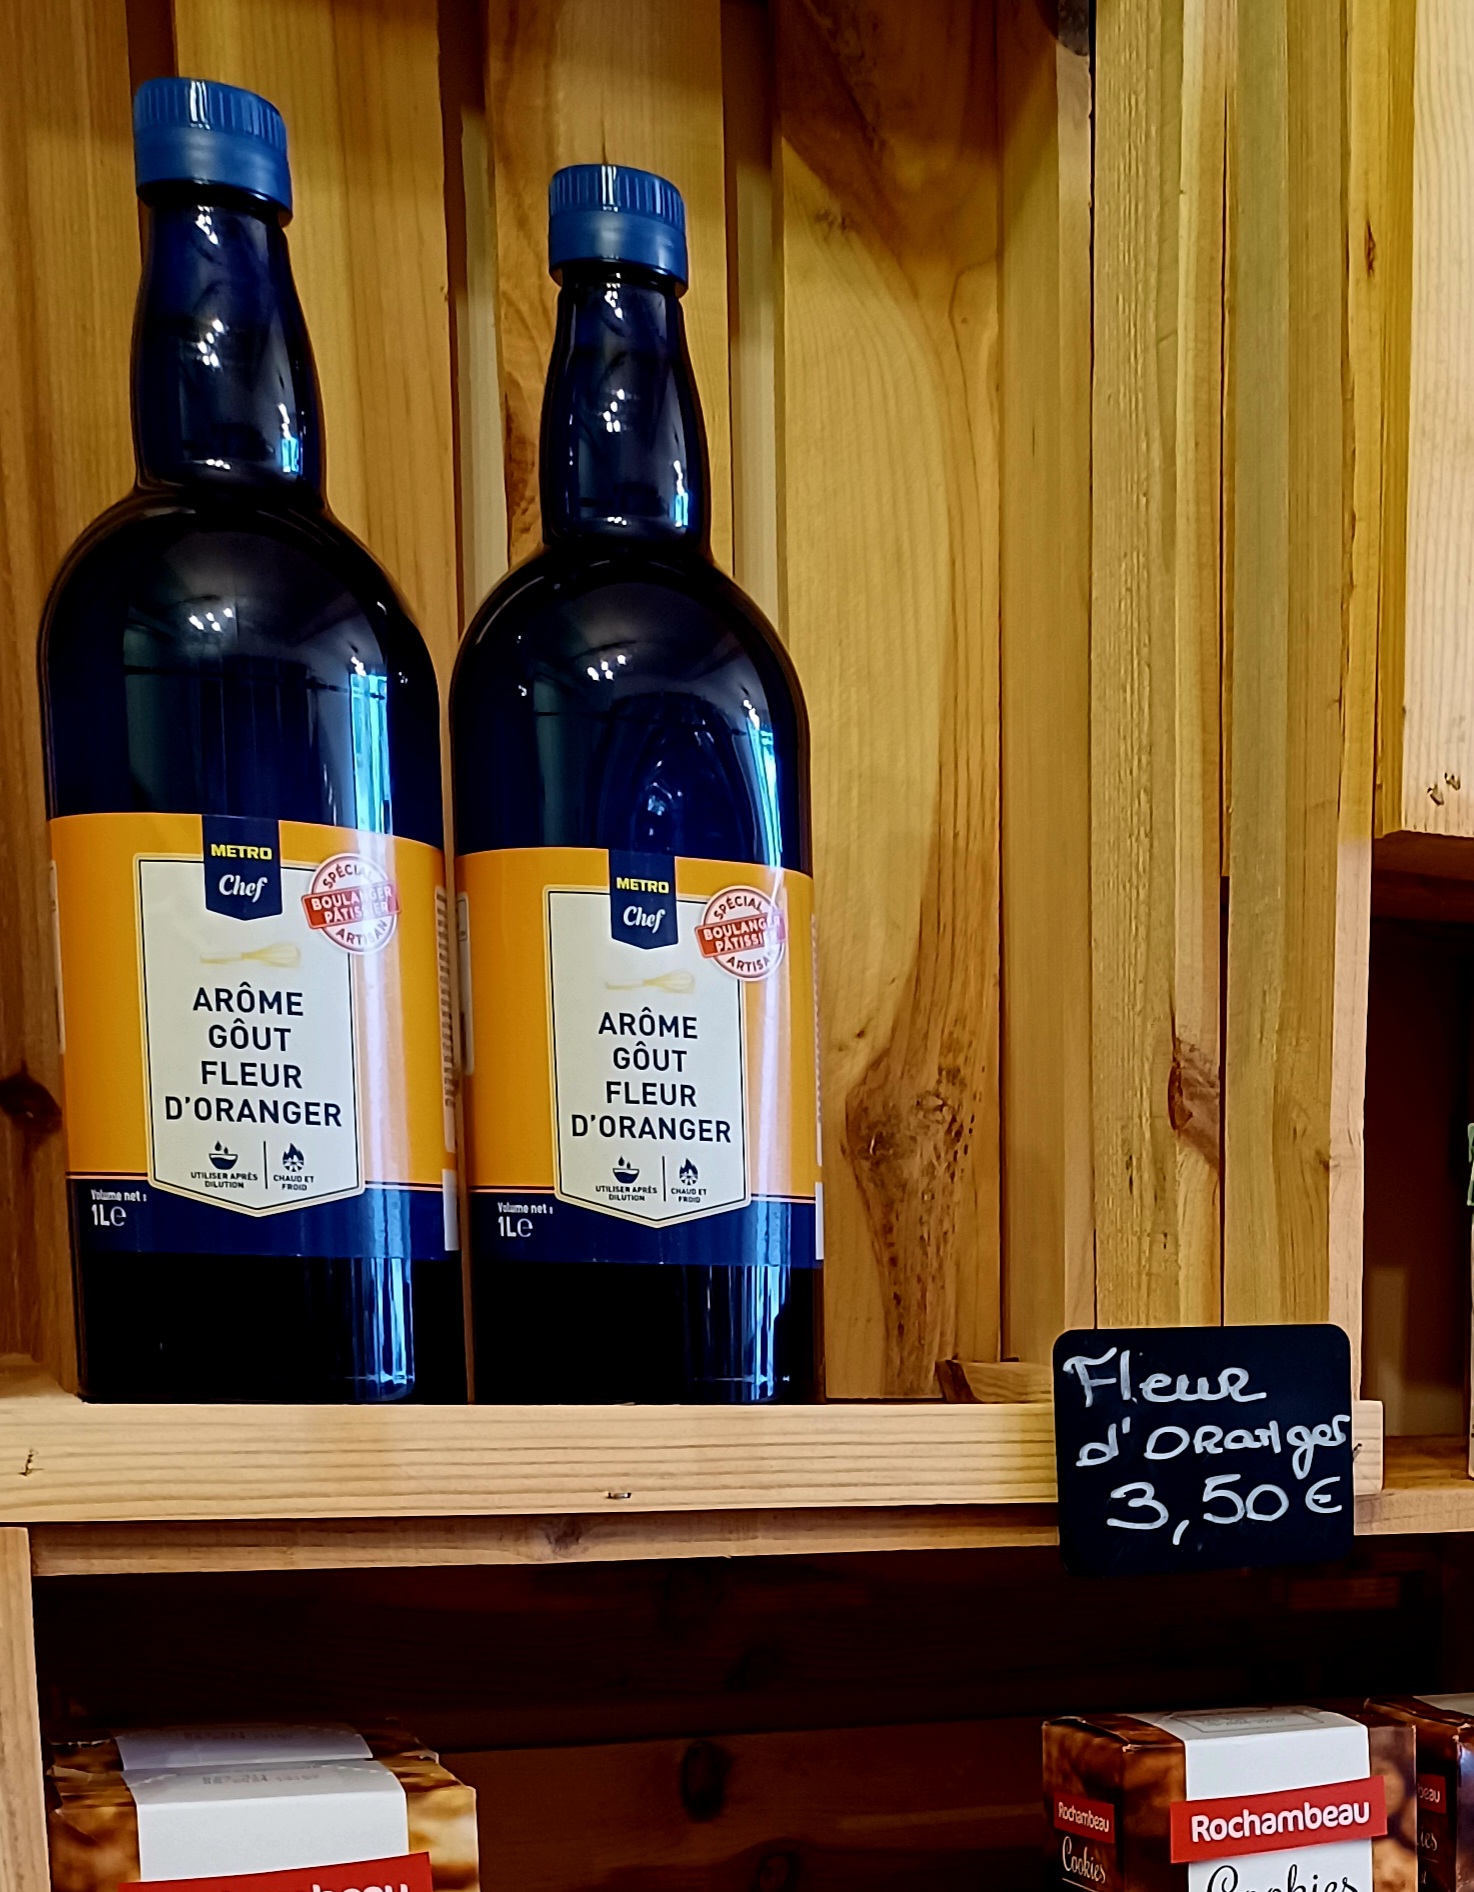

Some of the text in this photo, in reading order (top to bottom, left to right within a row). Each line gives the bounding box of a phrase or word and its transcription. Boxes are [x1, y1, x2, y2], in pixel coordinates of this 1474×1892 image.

[210, 843, 273, 861] METRO
[218, 873, 268, 904] Chef
[616, 876, 670, 895] METRO
[622, 905, 665, 934] Chef
[713, 895, 763, 920] SPÉCIAL
[192, 981, 304, 1018] ARÔME
[208, 1018, 292, 1053] GÔUT
[598, 1006, 698, 1040] ARÔME
[612, 1040, 688, 1073] GÔUT
[200, 1060, 303, 1090] FLEUR
[605, 1080, 697, 1108] FLEUR
[164, 1096, 342, 1128] D'ORANGER
[571, 1113, 732, 1144] D'ORANGER
[1058, 1800, 1110, 1833] Rochambeau
[1191, 1799, 1372, 1843] Rochambeau
[1062, 1835, 1106, 1884] Cookies
